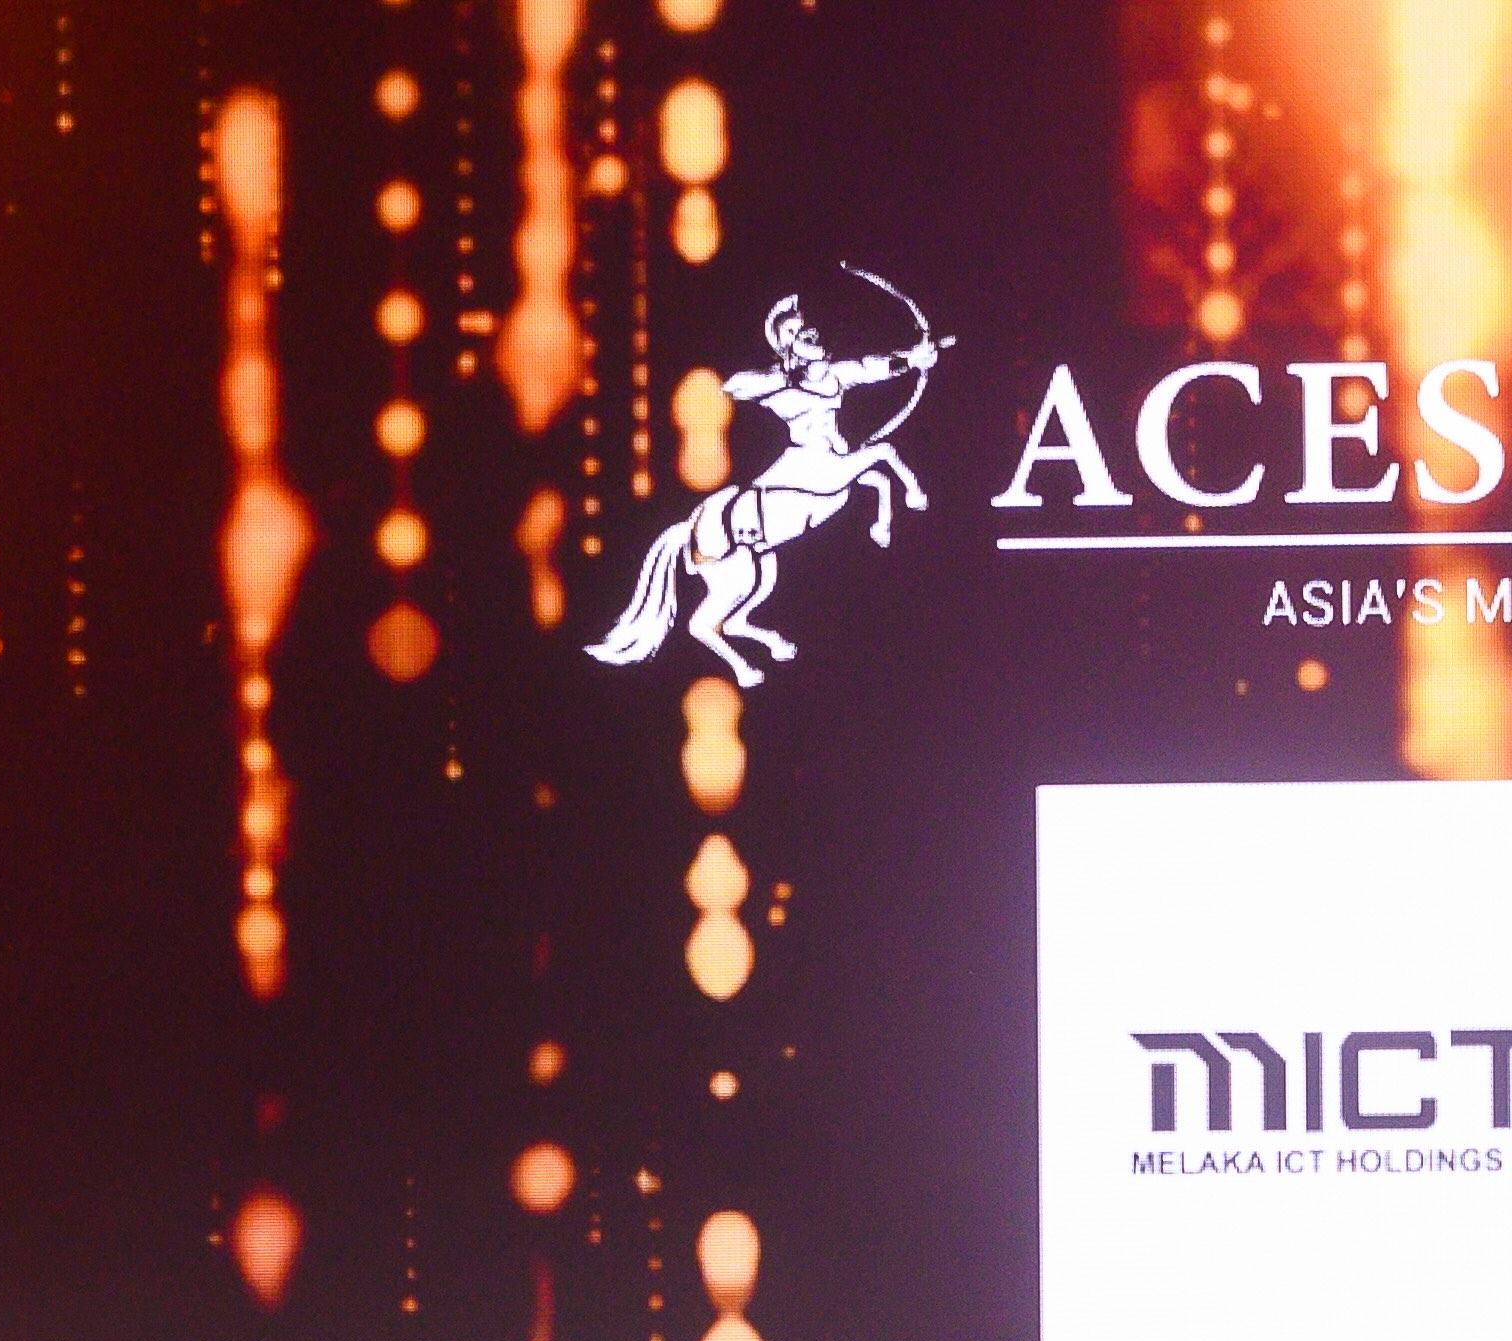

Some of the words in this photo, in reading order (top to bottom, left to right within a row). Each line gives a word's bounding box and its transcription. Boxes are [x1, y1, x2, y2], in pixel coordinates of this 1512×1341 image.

[989, 356, 1506, 509] ACES
[1262, 577, 1447, 628] ASIA'S
[1131, 1150, 1266, 1175] MELAKA
[1276, 1150, 1325, 1174] ICT
[1336, 1148, 1503, 1173] HOLDINGS
